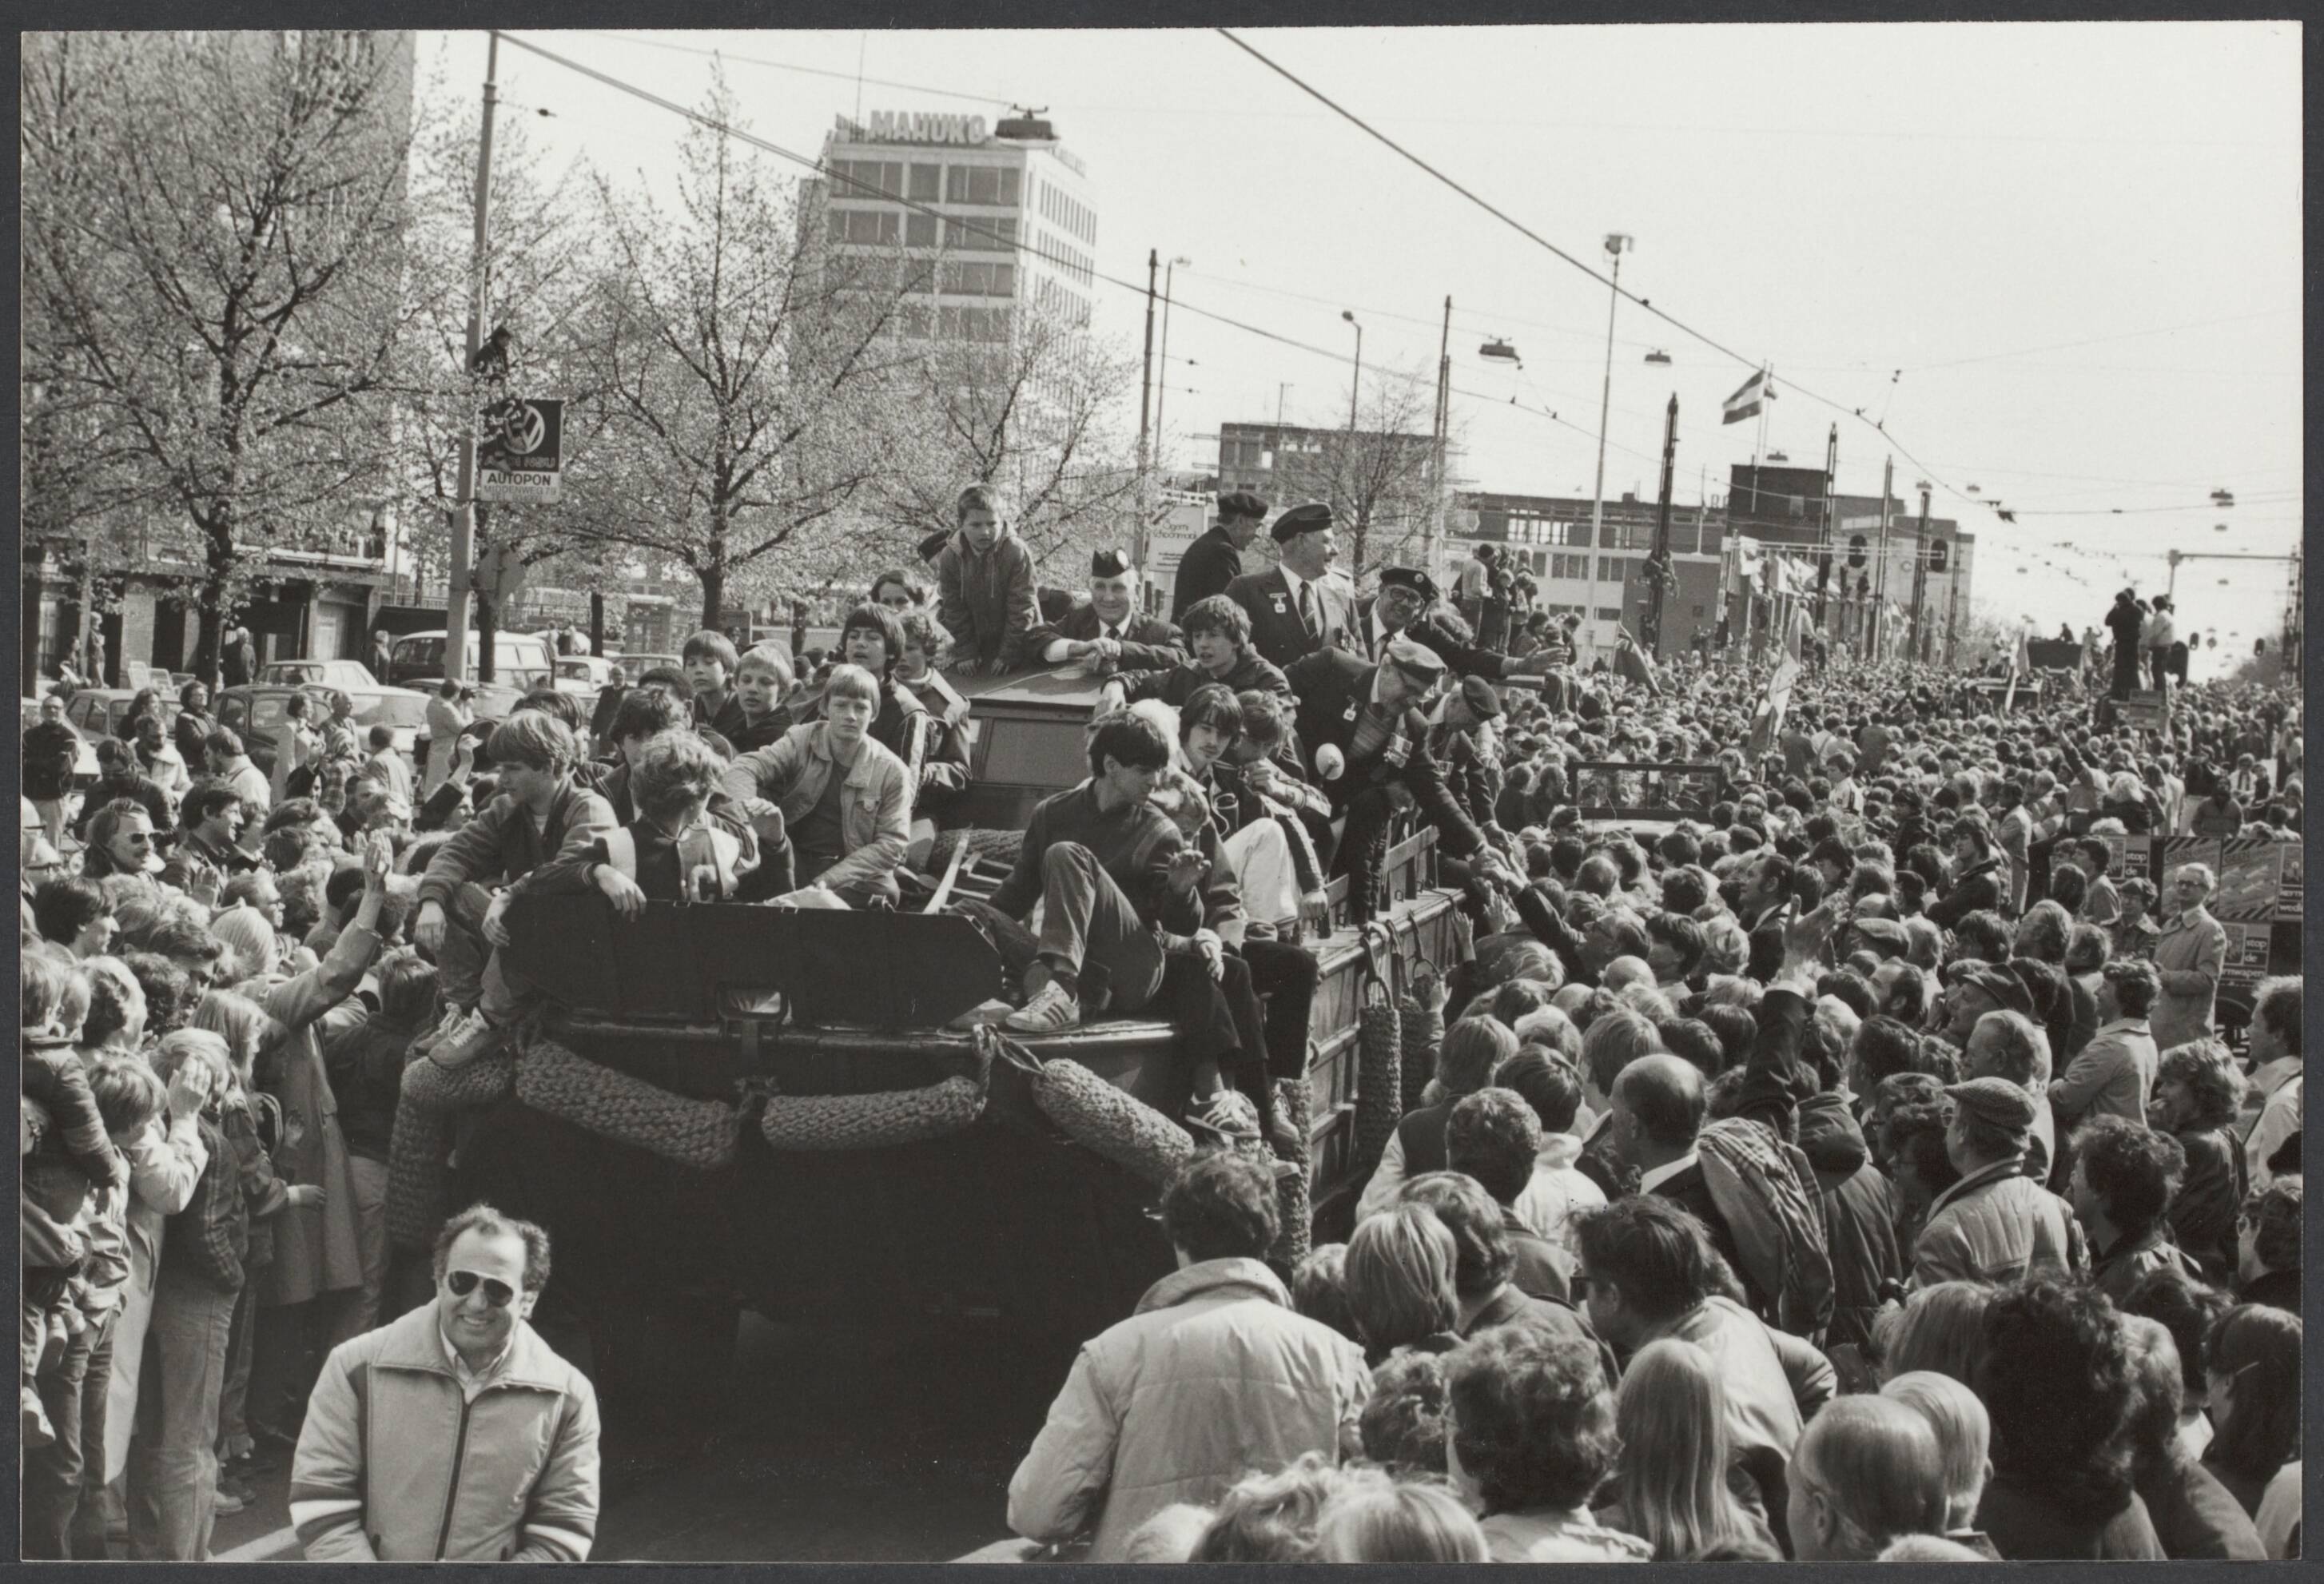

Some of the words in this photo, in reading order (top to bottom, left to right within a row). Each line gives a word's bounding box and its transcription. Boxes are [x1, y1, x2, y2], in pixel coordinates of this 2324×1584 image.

[869, 110, 986, 145] MAHUKO
[487, 472, 551, 486] AUTOPON
[2126, 853, 2147, 863] stop
[2125, 866, 2138, 876] de
[2246, 940, 2267, 950] stop
[2244, 952, 2258, 962] de
